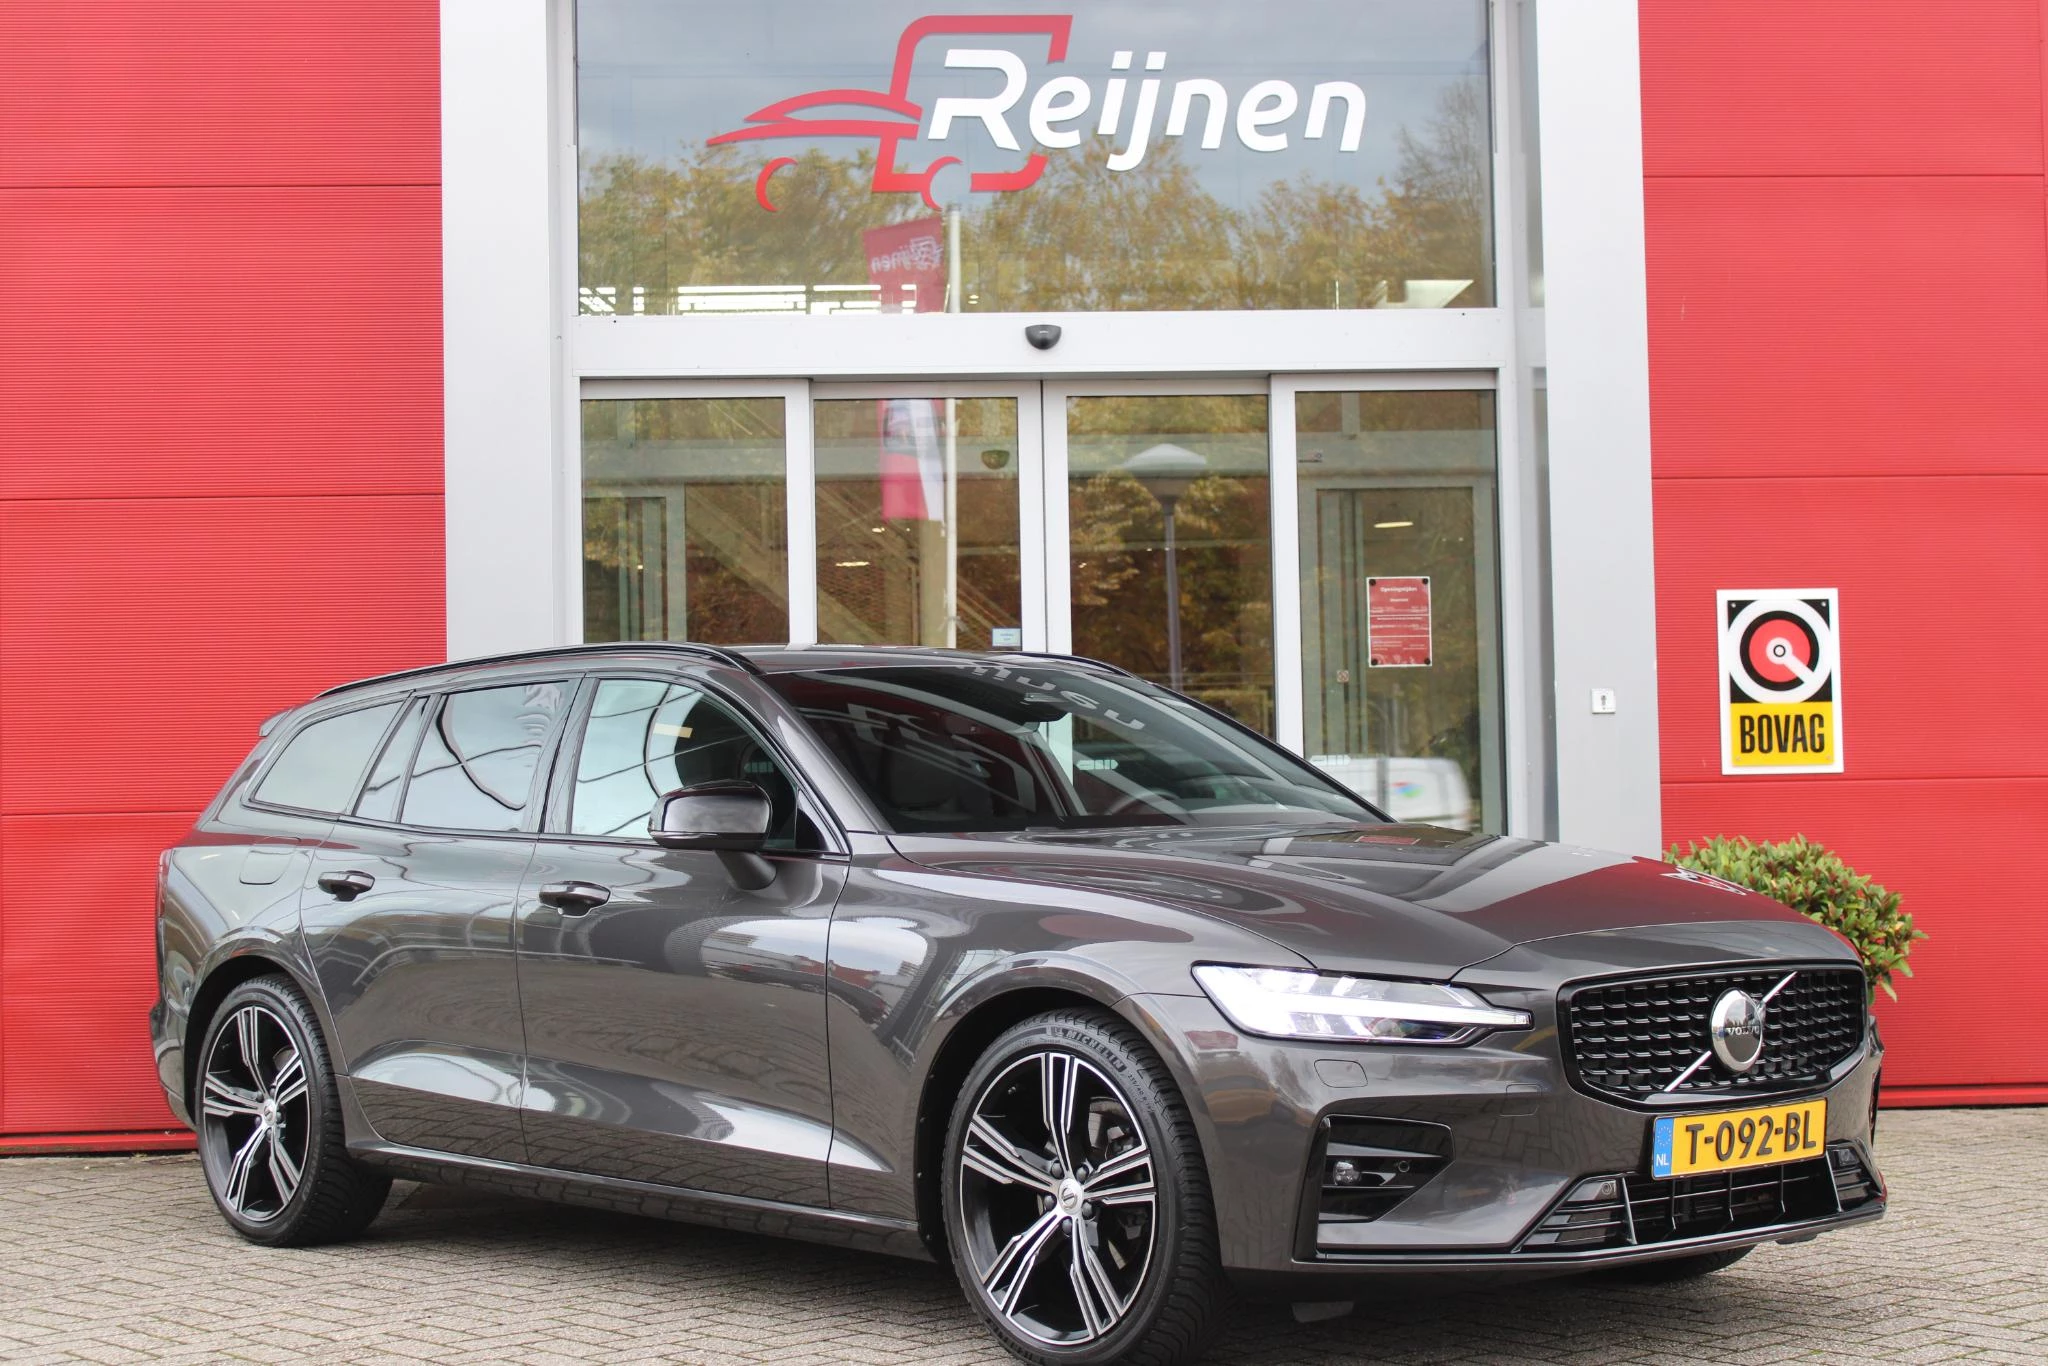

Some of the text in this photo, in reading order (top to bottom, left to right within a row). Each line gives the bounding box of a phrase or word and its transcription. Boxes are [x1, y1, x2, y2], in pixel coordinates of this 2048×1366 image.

[928, 49, 1367, 171] Reijnen
[1740, 713, 1825, 754] BOVAG
[1065, 1029, 1125, 1072] MICHELIN
[1686, 1110, 1817, 1165] T-092-BL
[1656, 1153, 1669, 1166] NL
